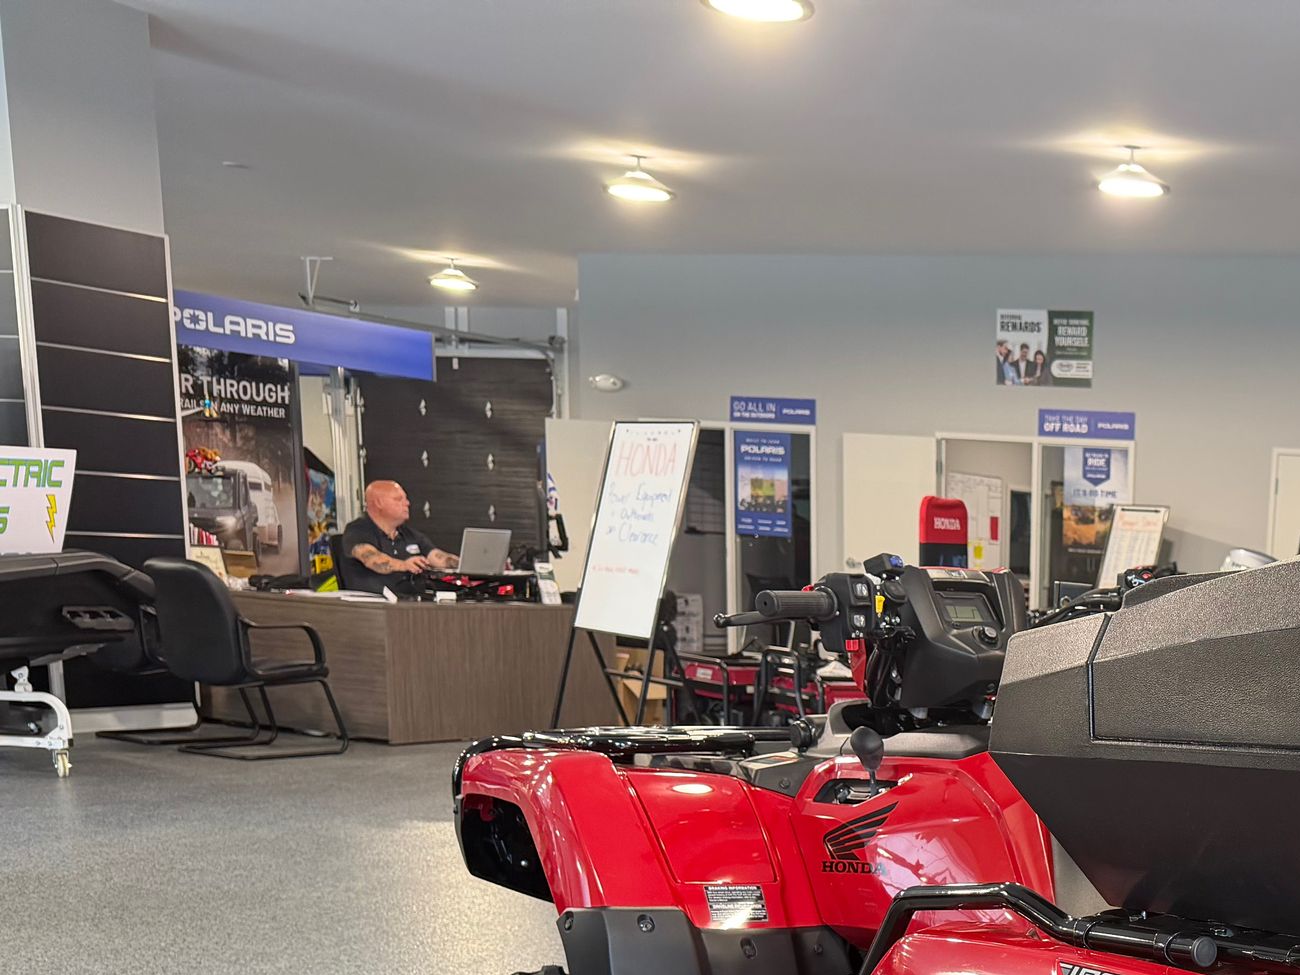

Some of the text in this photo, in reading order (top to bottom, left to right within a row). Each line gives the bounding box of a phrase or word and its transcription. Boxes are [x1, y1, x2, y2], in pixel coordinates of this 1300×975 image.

[173, 306, 296, 344] POLARIS
[1000, 321, 1041, 333] REWARDS
[199, 376, 290, 404] THROUGH
[221, 402, 240, 413] ANY
[242, 404, 286, 419] WEATHER
[733, 401, 776, 412] GO ALL IN
[1043, 422, 1089, 434] OFF ROAD
[740, 444, 786, 455] POLARIS
[615, 442, 677, 477] HONDA
[933, 516, 961, 531] HONDA
[821, 860, 888, 876] HONDA
